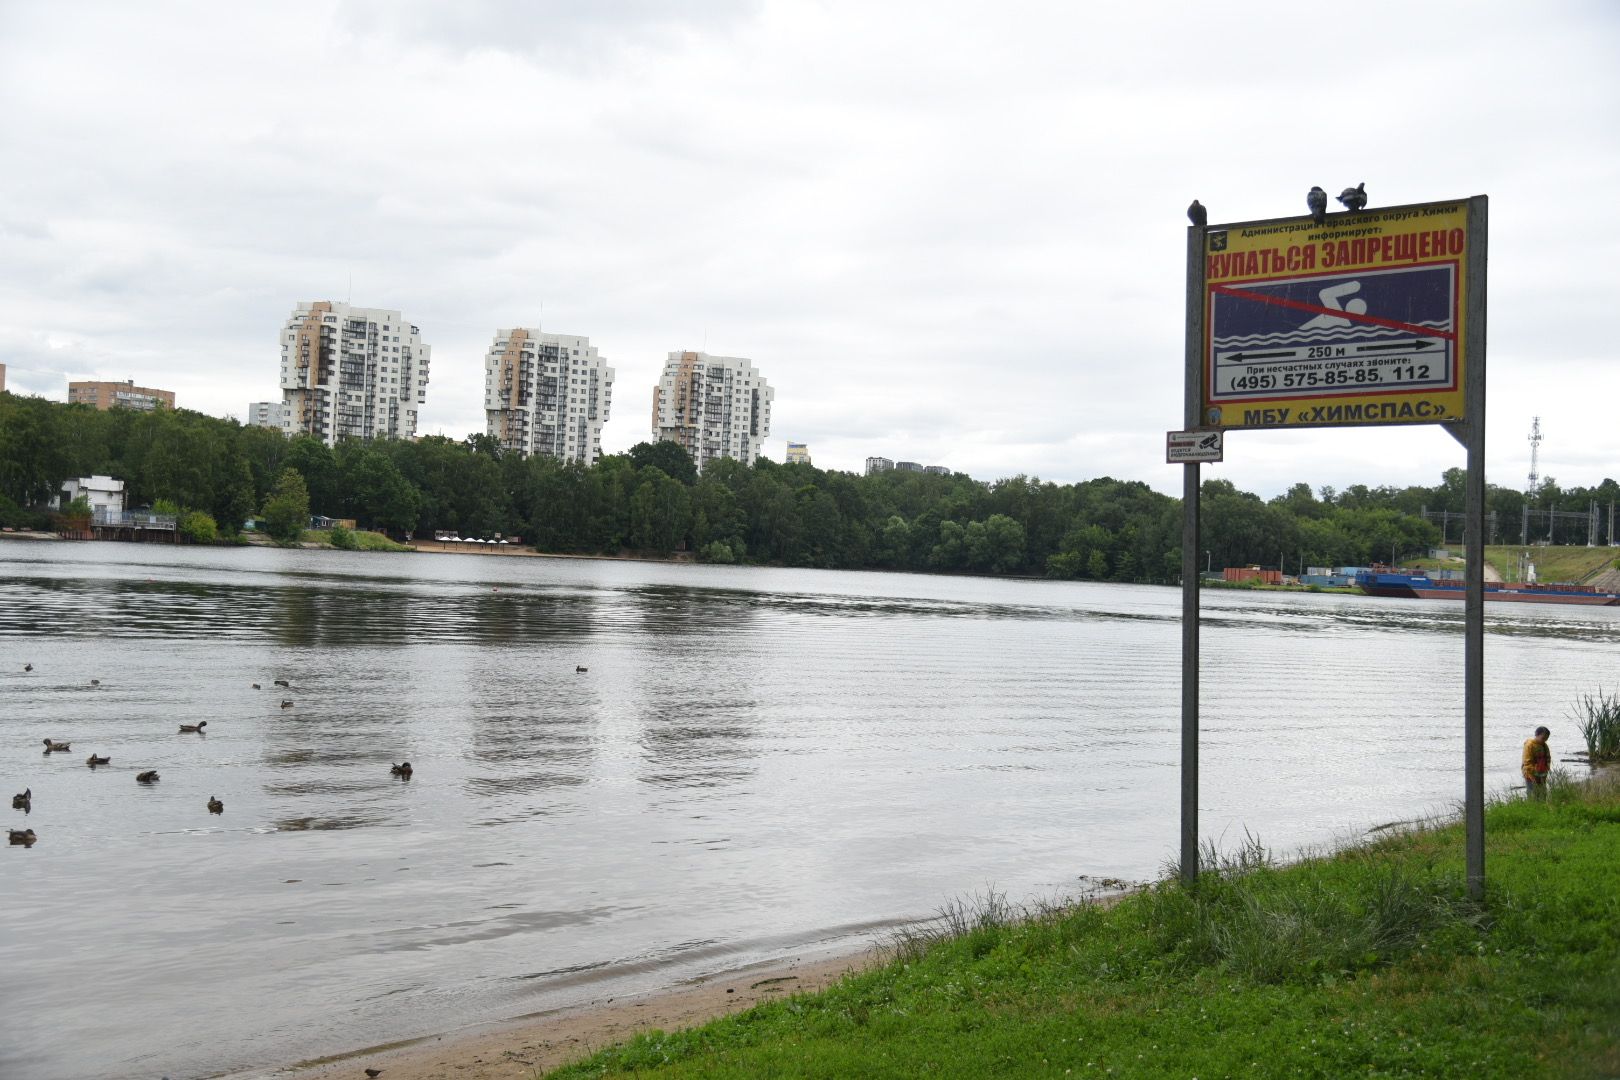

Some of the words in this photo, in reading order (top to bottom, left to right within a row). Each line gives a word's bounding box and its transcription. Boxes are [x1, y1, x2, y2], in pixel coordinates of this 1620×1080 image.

[1383, 211, 1419, 222] округа
[1422, 205, 1458, 217] Химки
[1308, 226, 1382, 241] информирует:
[1207, 244, 1316, 280] КУПАТЬСЯ
[1321, 227, 1464, 268] ЗАПРЕЩЕНО
[1307, 346, 1332, 358] 250
[1335, 347, 1345, 356] м
[1246, 366, 1264, 375] При
[1266, 362, 1322, 373] несчастных
[1325, 359, 1364, 370] случаях
[1366, 357, 1411, 367] звоните:
[1230, 375, 1277, 391] (495)
[1283, 368, 1383, 387] 575-85-85,
[1392, 364, 1430, 380] 112
[1244, 408, 1290, 424] МБУ
[1298, 400, 1446, 422] «ХИМСПАС»
